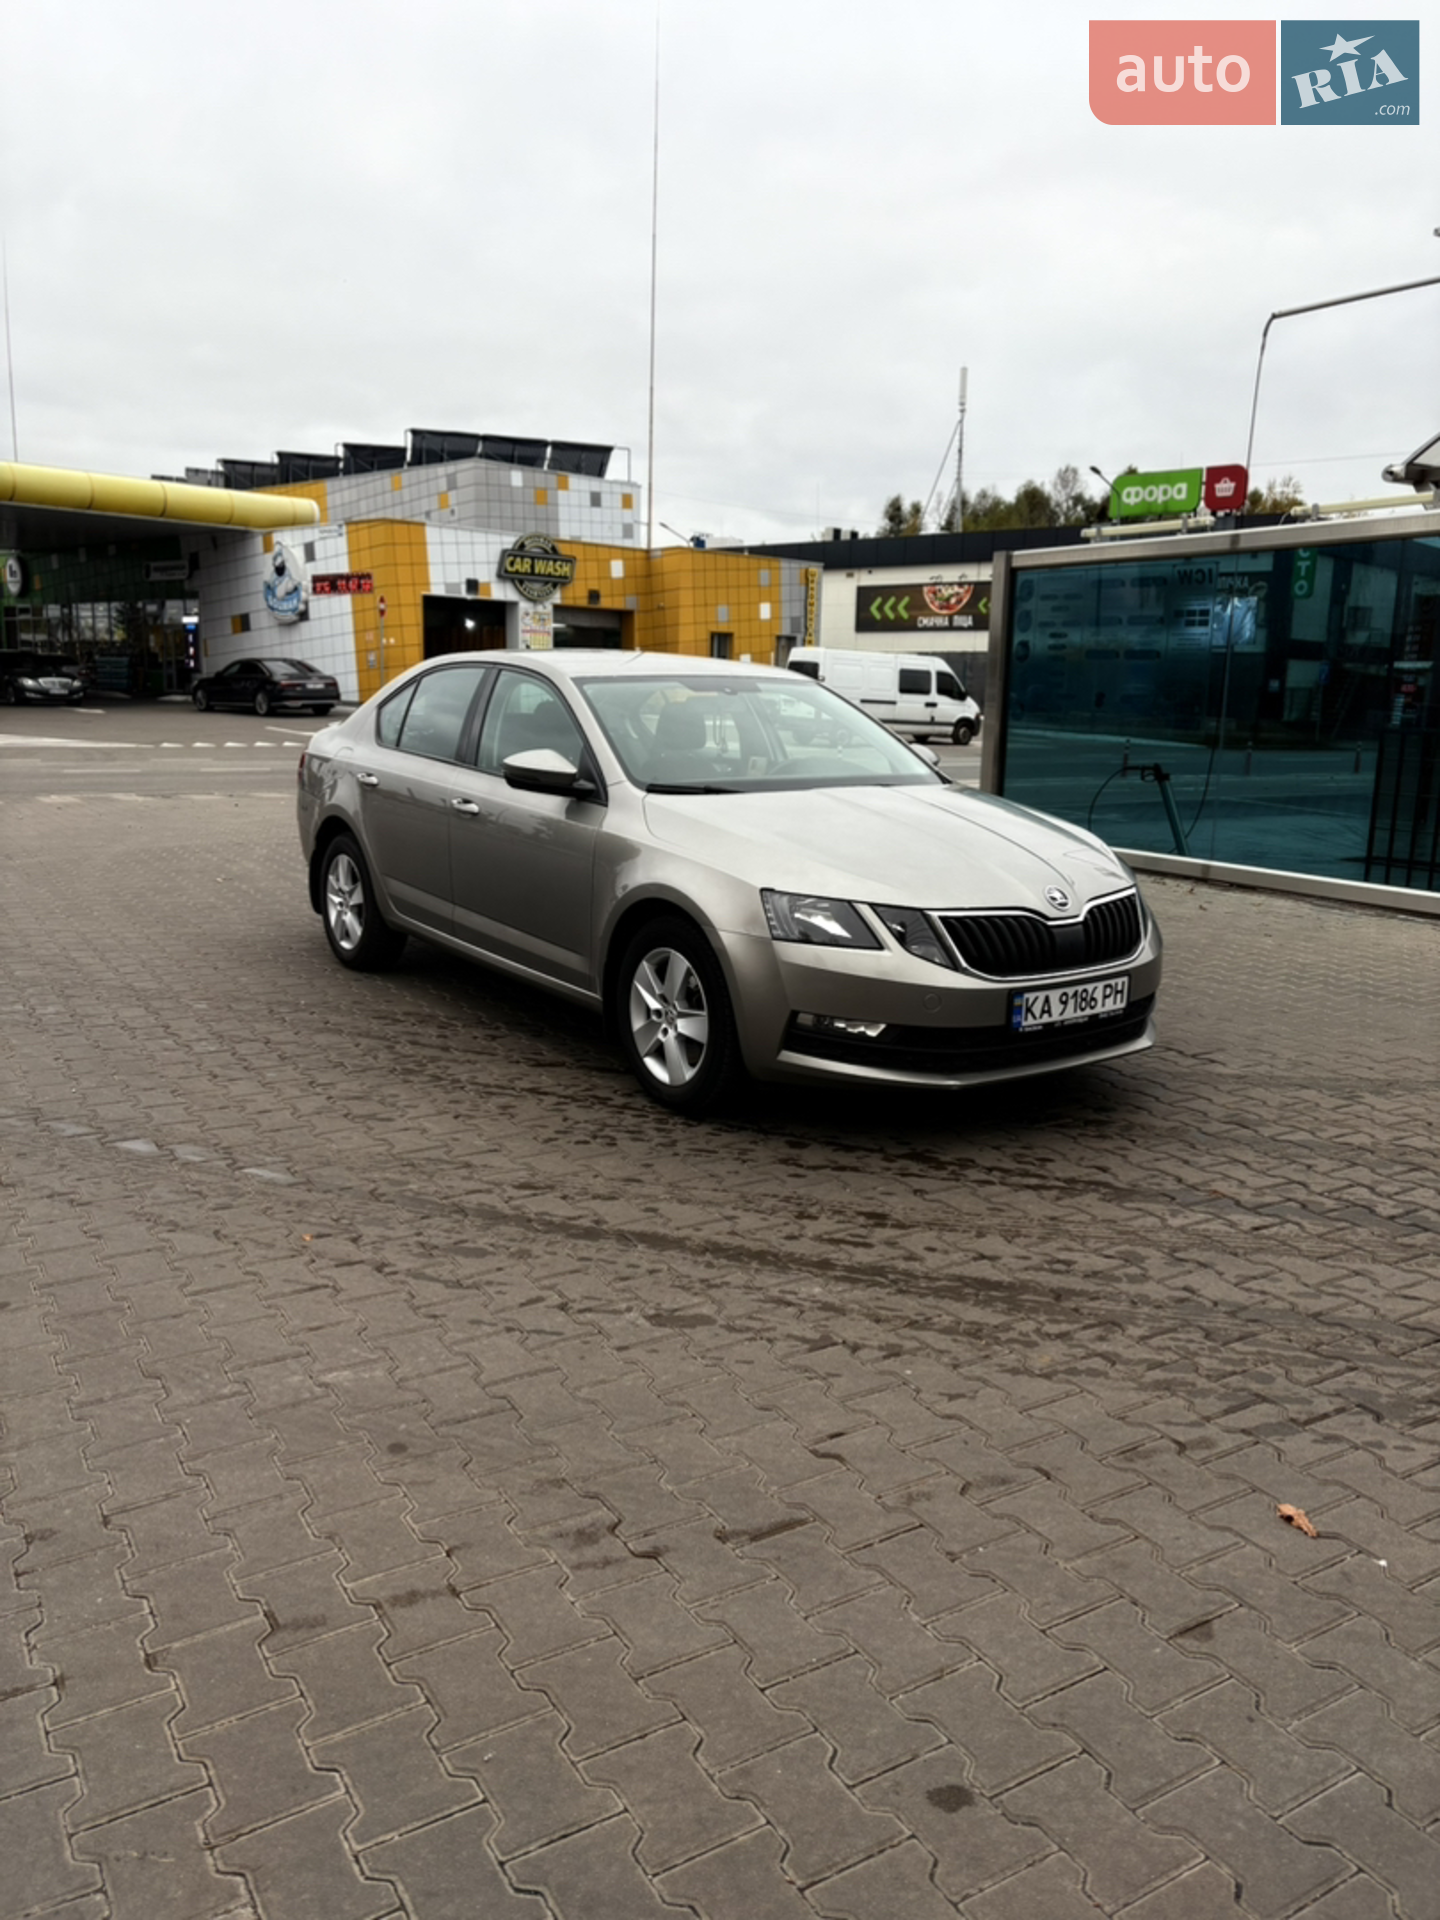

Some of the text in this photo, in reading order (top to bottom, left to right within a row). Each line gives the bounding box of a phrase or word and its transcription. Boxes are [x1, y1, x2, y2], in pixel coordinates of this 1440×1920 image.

[1122, 482, 1188, 505] фора
[505, 556, 572, 577] CAR WASH
[917, 615, 949, 628] СМАЧНА
[1023, 995, 1053, 1022] KA
[1058, 986, 1098, 1016] 9186
[1101, 980, 1126, 1008] PH
